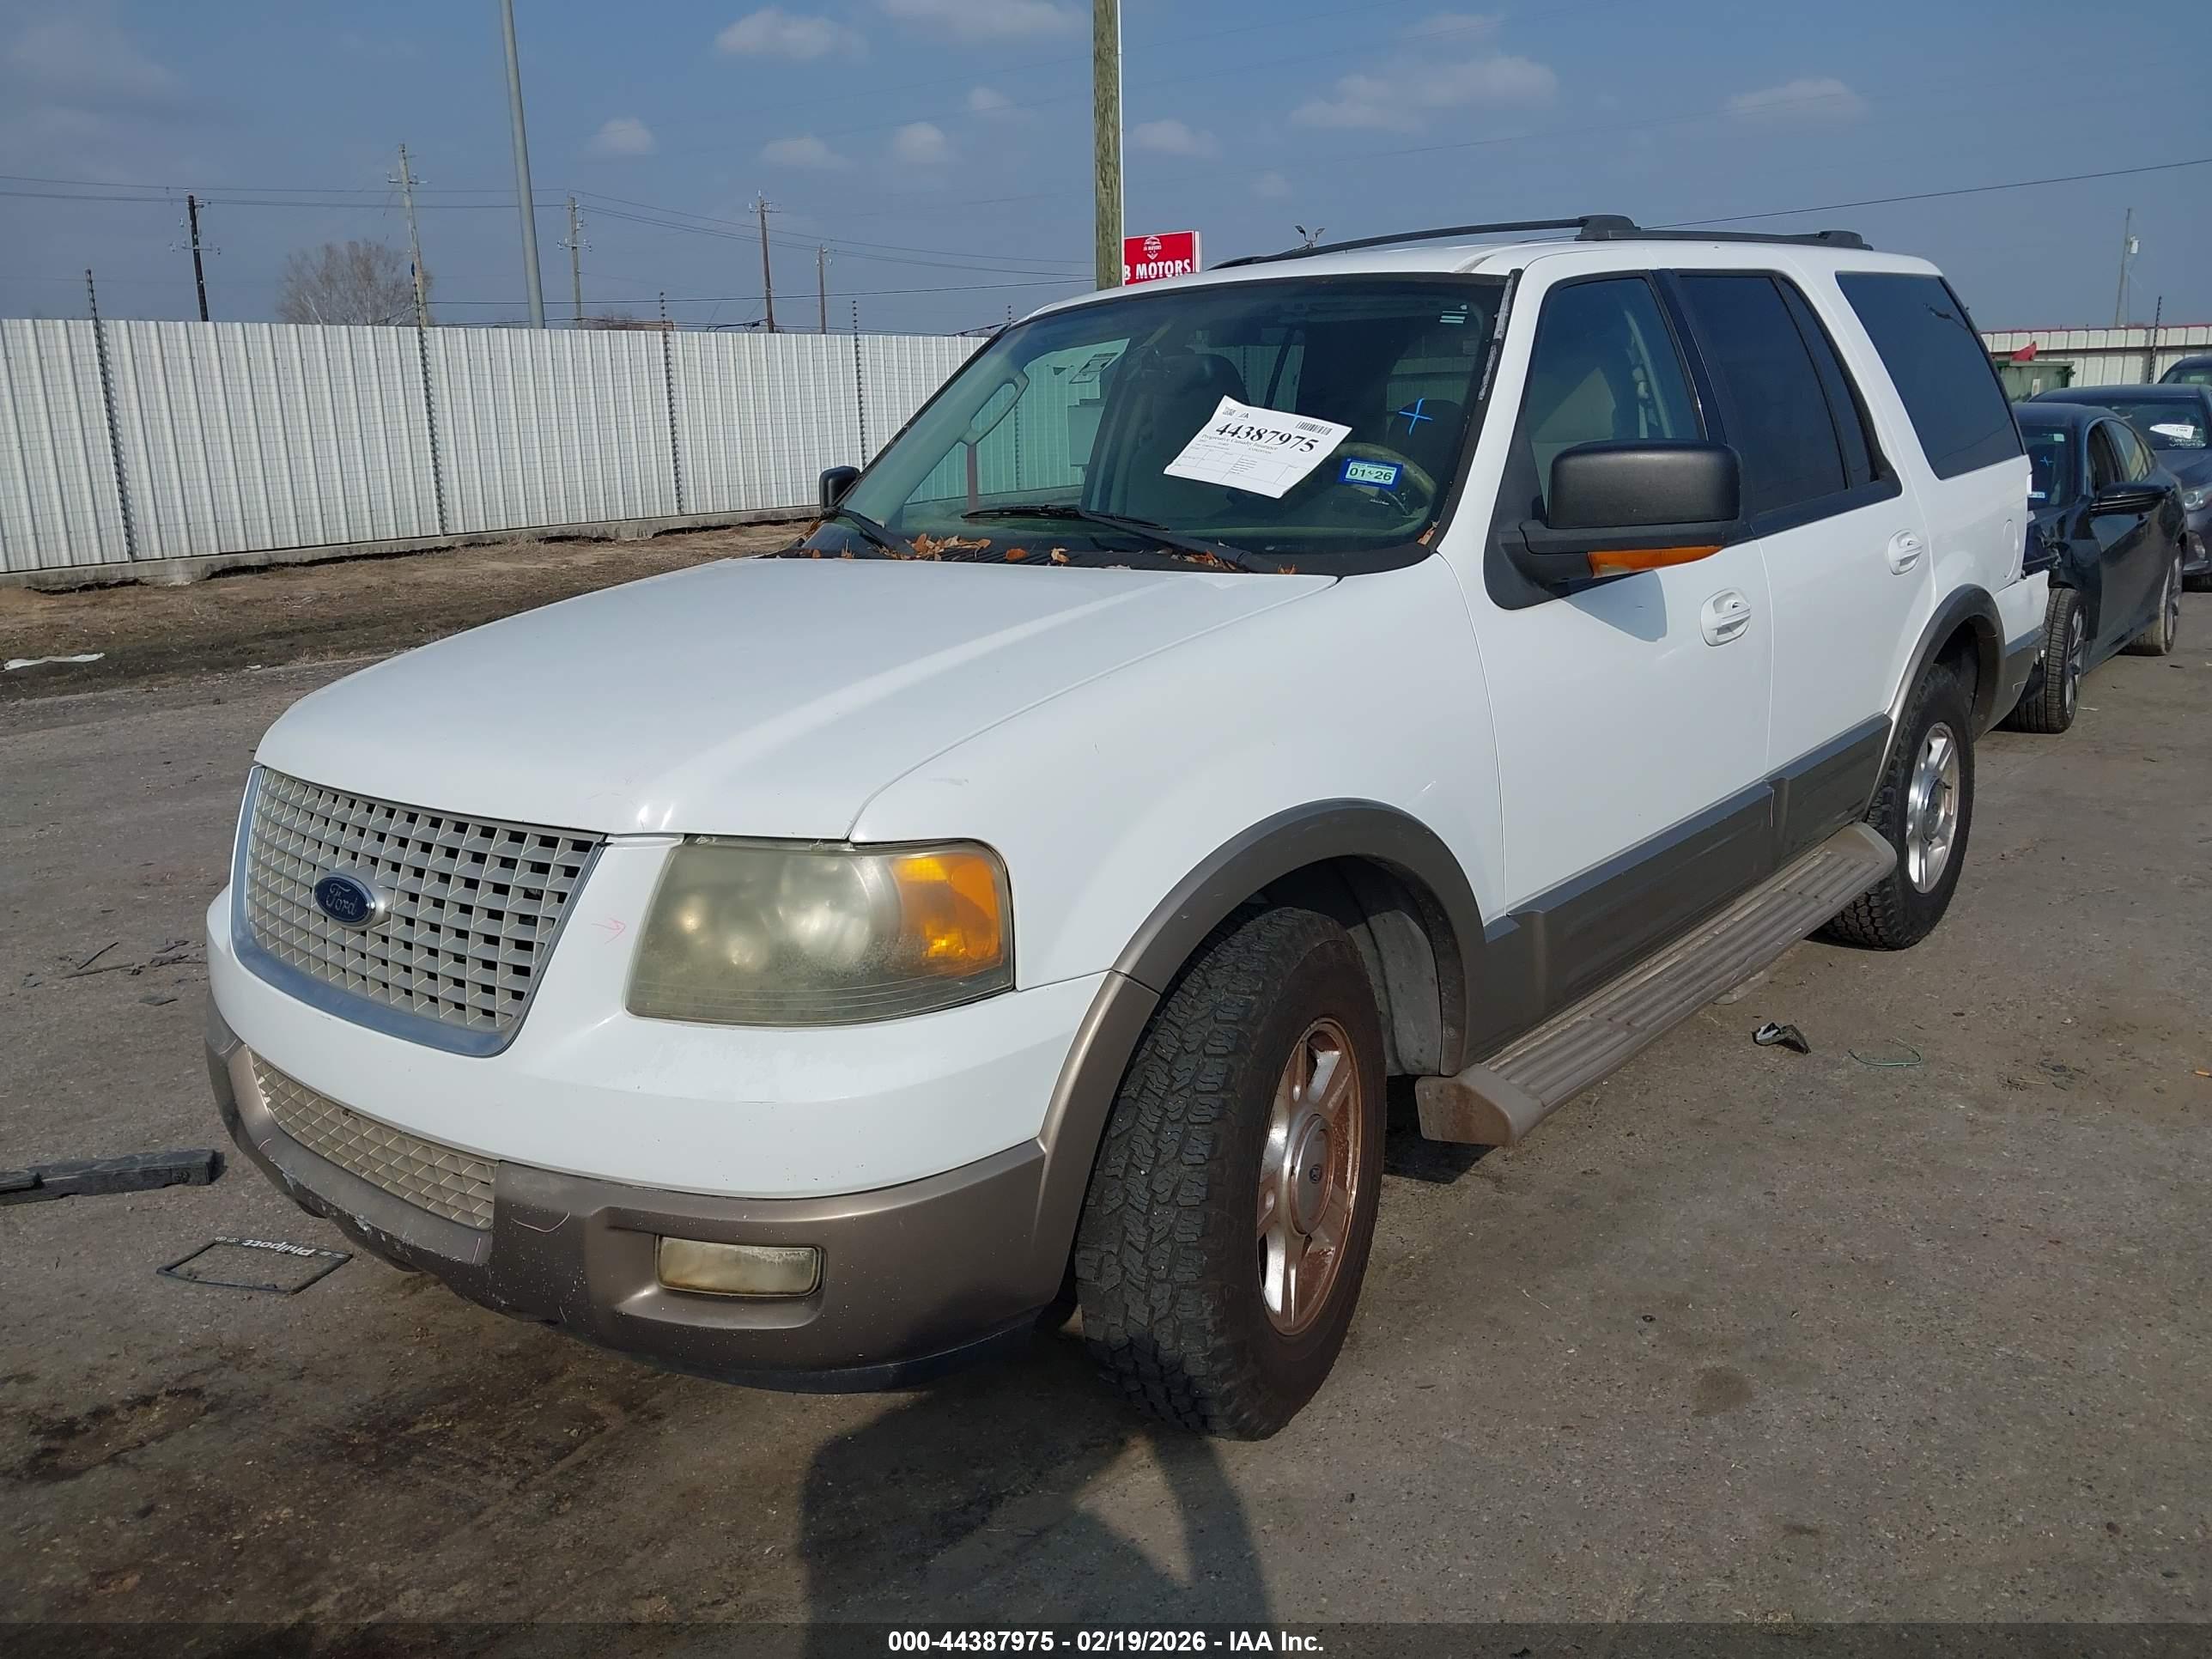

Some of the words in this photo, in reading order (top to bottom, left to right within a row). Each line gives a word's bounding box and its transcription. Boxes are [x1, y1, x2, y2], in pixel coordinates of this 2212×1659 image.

[1136, 258, 1191, 280] MOTORS
[1216, 422, 1319, 453] 44387975
[1350, 467, 1365, 477] 01
[1374, 471, 1393, 481] 26
[325, 883, 358, 915] Ford
[242, 1239, 316, 1256] Philpott
